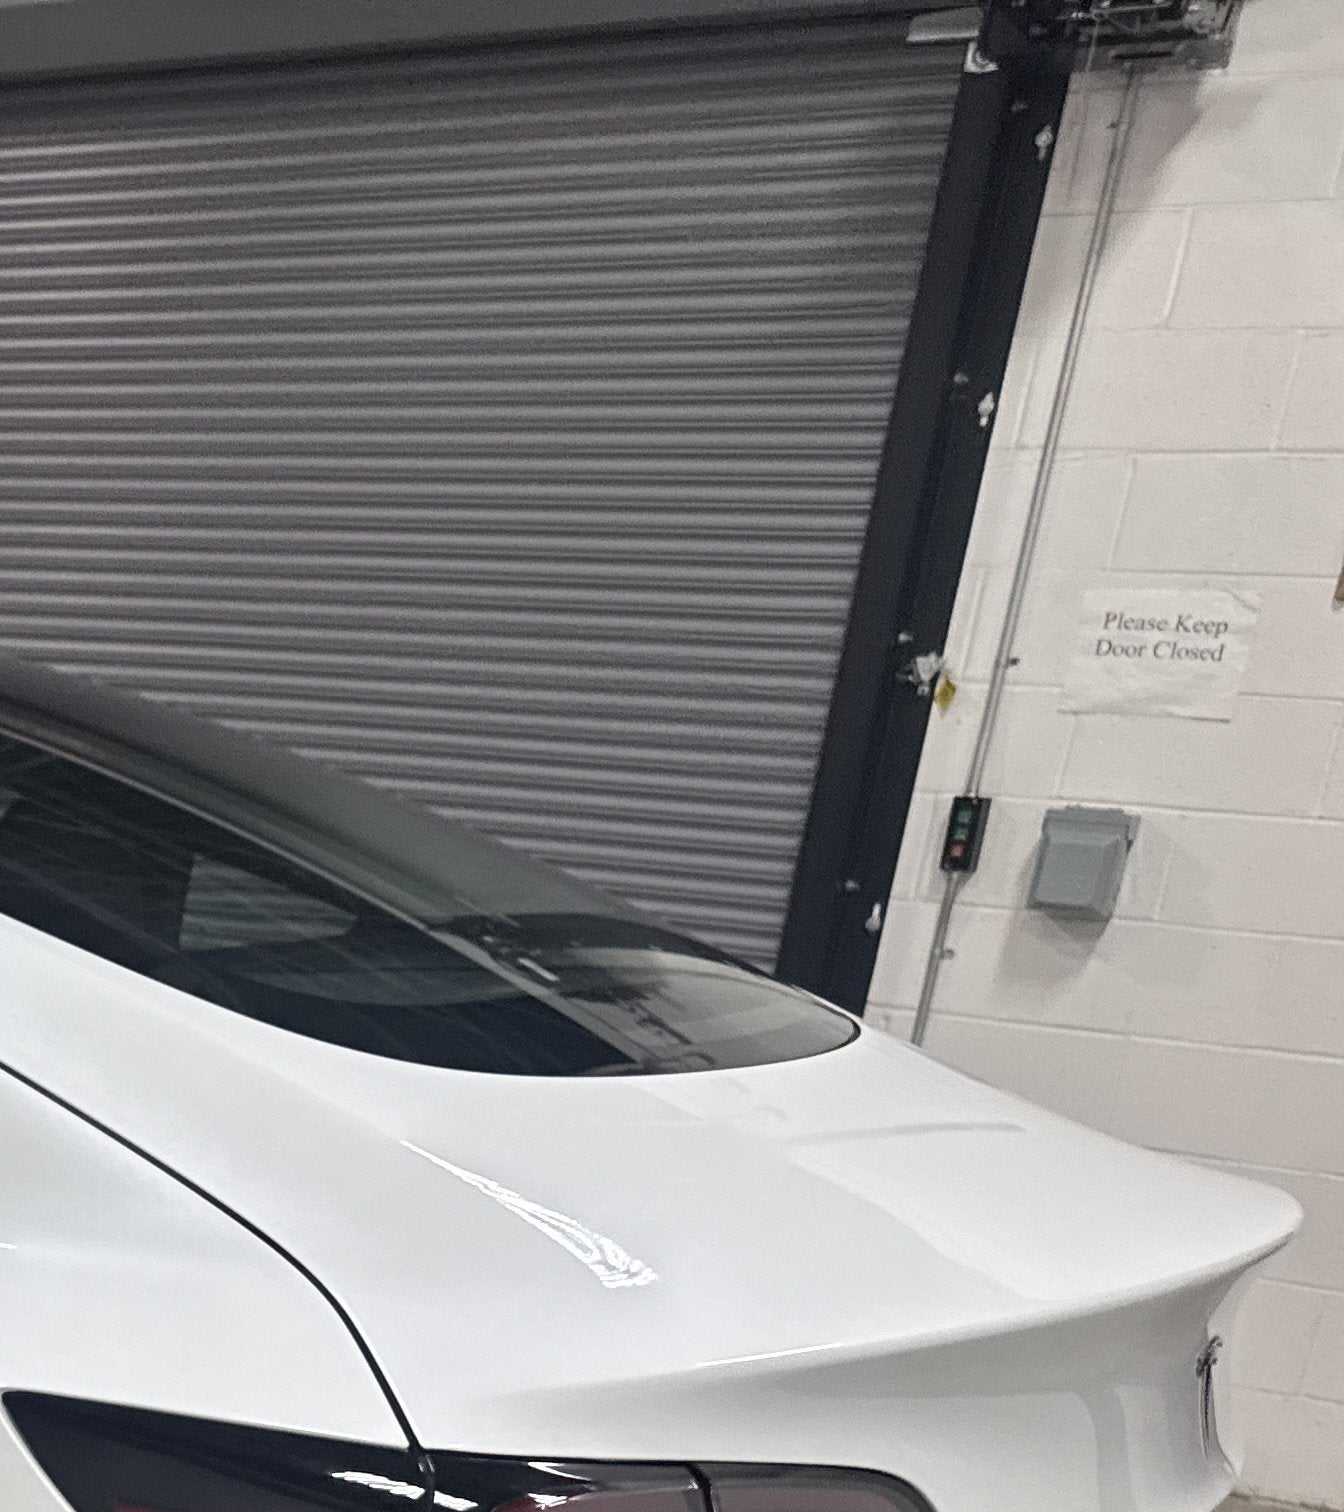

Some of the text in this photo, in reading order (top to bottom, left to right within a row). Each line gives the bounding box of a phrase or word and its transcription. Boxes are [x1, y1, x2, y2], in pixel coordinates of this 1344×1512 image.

[1102, 611, 1229, 638] Please Keep
[1094, 638, 1225, 662] Door Closed
